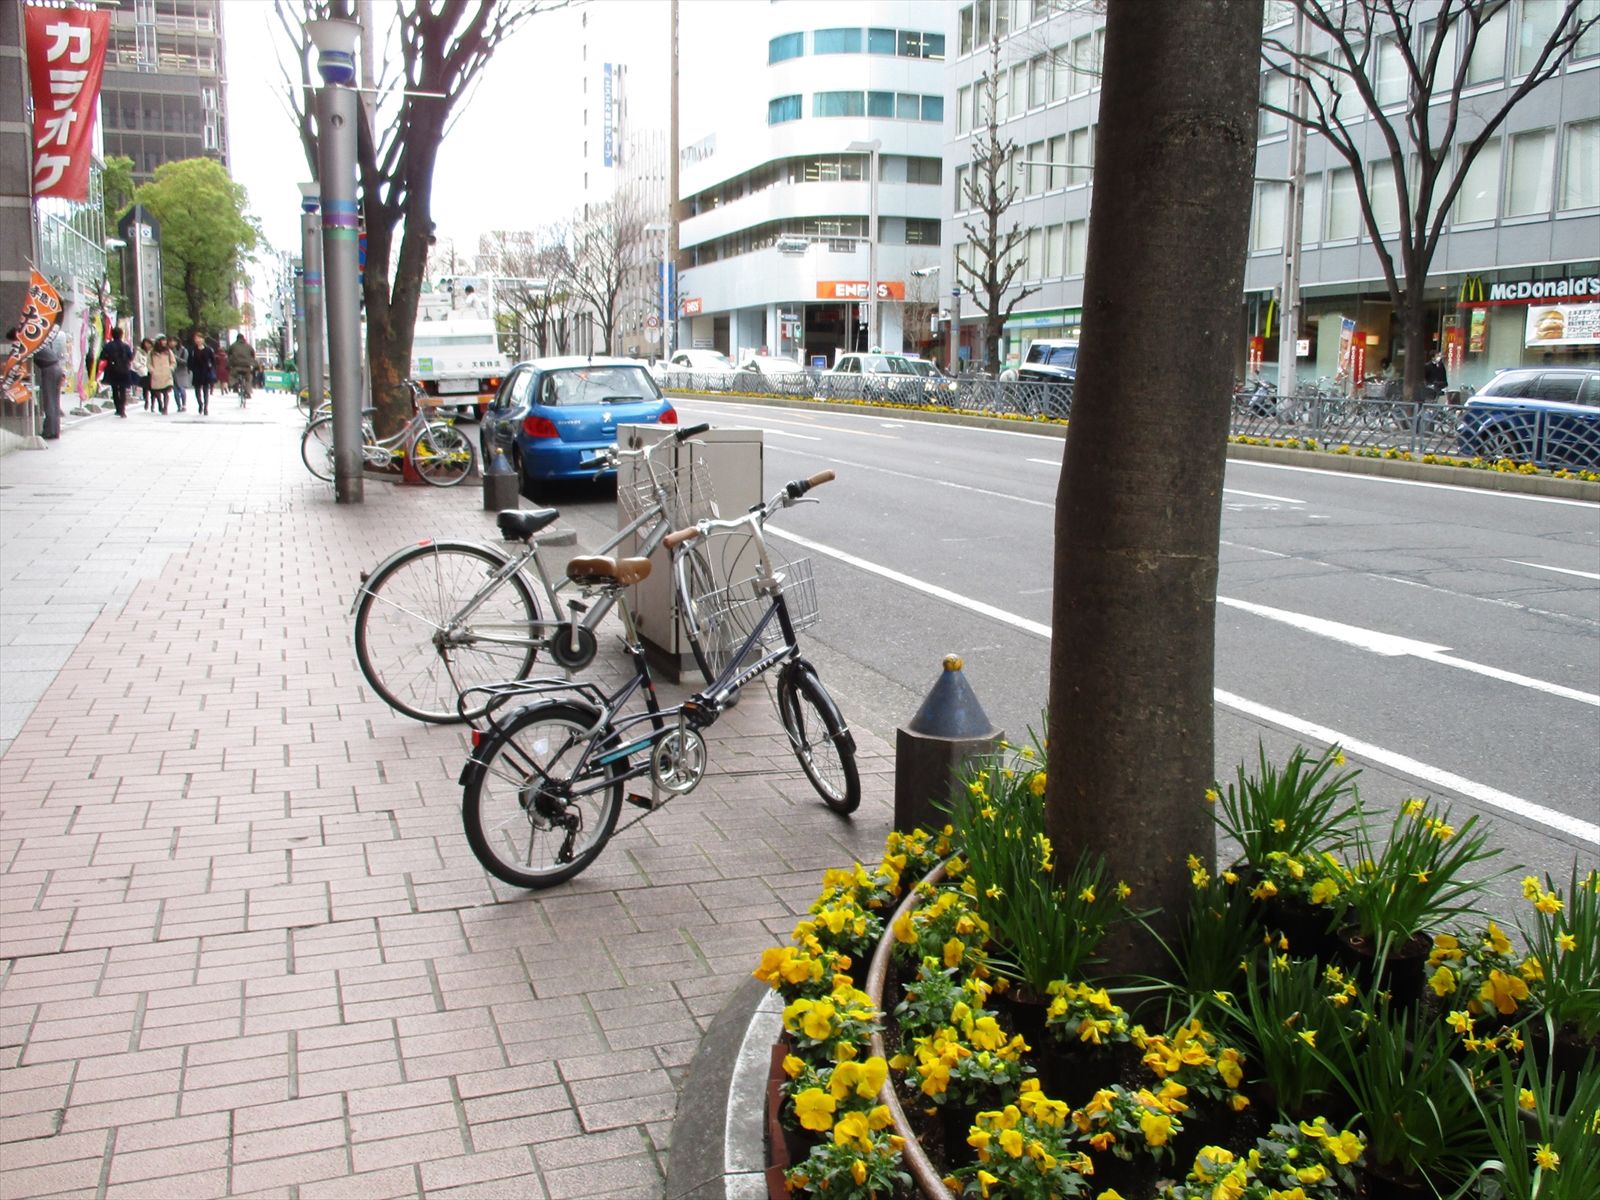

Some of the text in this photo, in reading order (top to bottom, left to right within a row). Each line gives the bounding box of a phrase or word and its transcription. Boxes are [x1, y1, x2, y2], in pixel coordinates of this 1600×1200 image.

[34, 22, 91, 194] カラオケ
[835, 283, 888, 297] ENES
[1489, 277, 1600, 301] McDonald's
